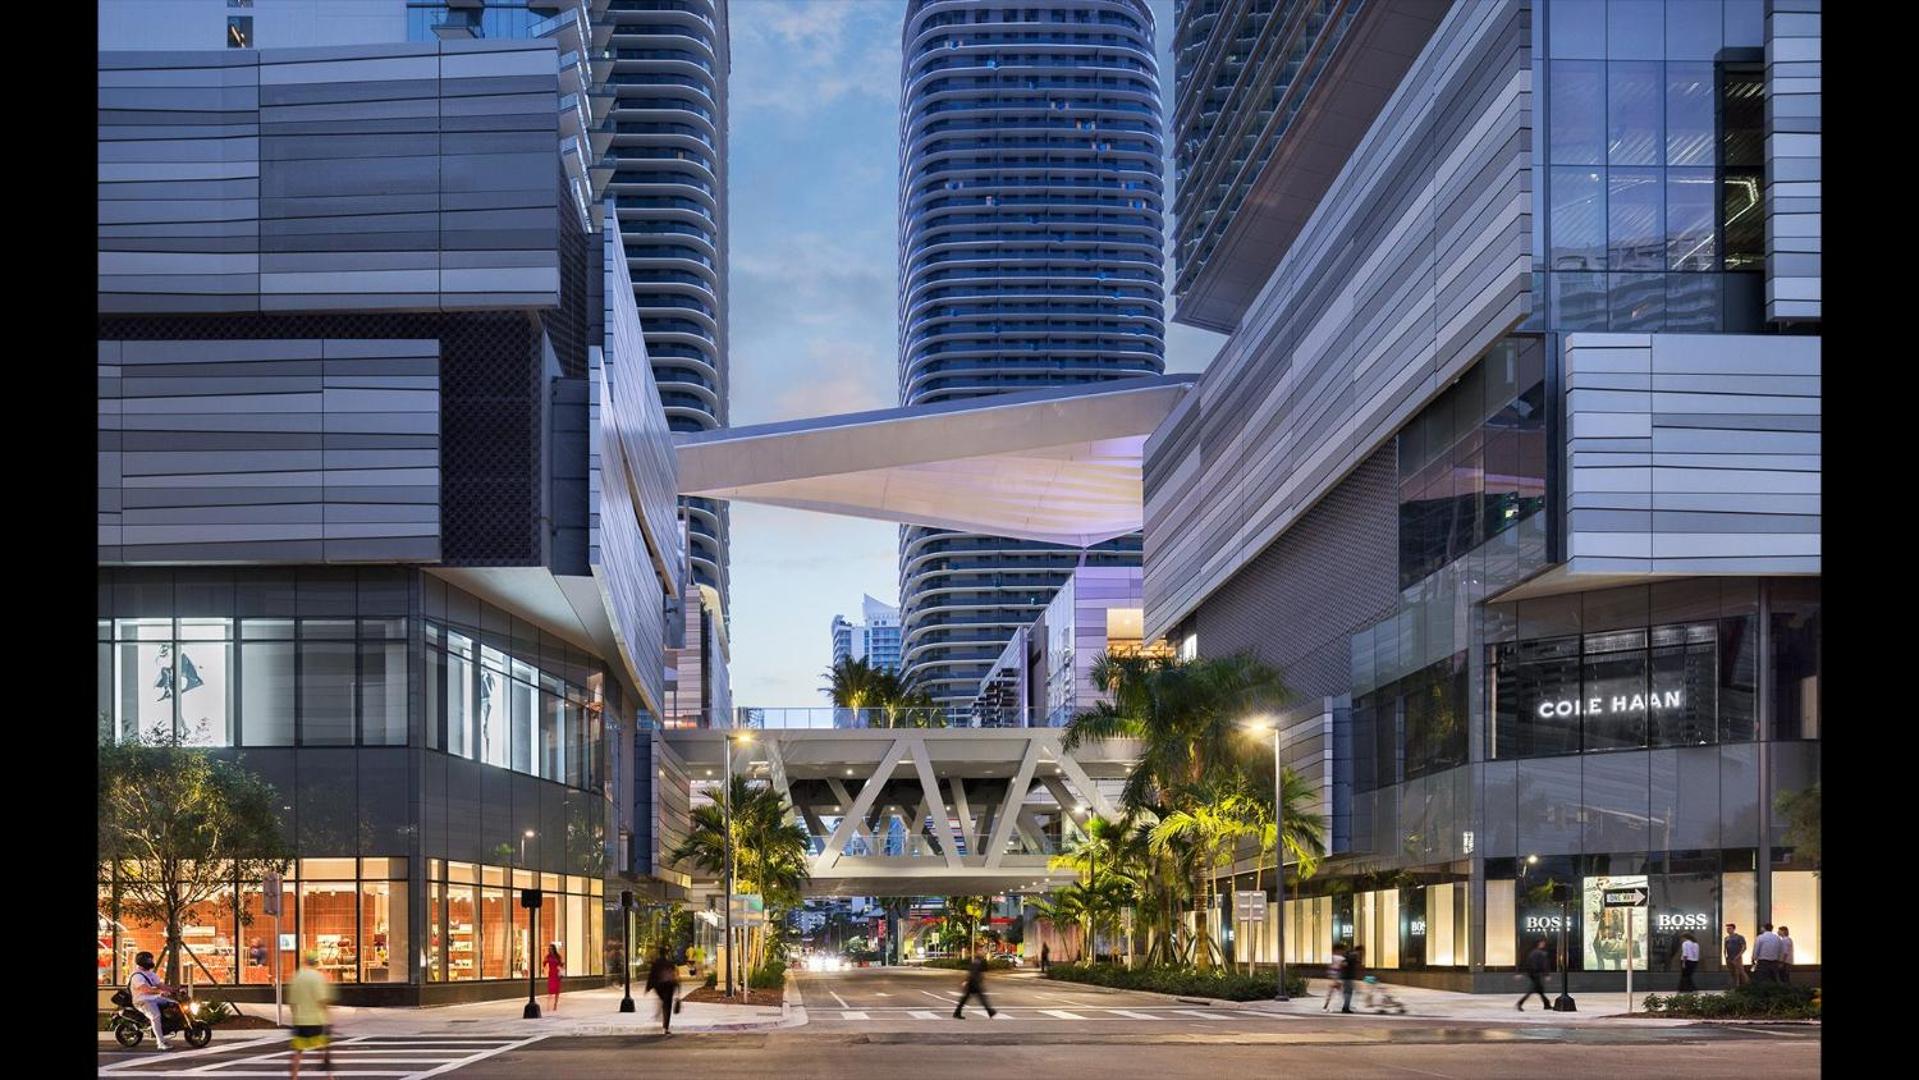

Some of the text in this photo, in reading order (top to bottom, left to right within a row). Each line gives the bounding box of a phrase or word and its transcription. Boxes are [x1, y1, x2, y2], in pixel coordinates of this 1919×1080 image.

[1539, 689, 1681, 718] COLE HAAN
[1658, 913, 1708, 926] BOSS
